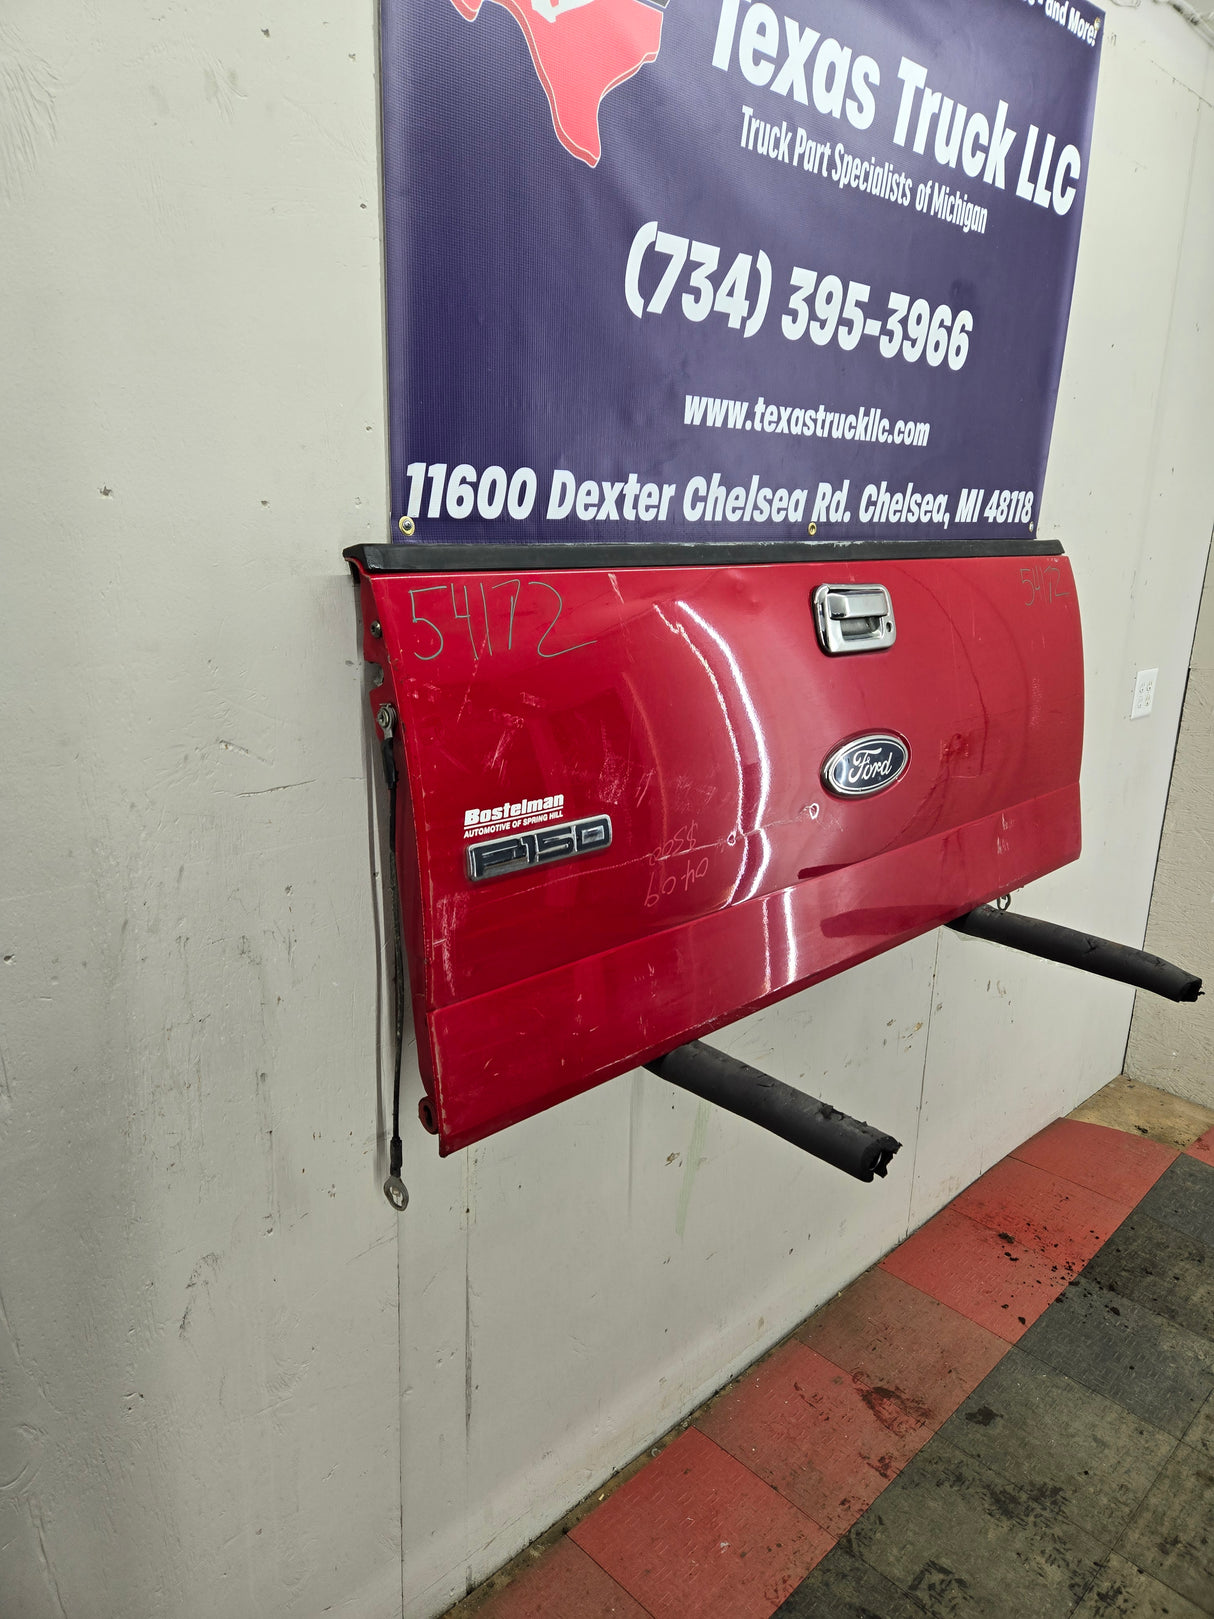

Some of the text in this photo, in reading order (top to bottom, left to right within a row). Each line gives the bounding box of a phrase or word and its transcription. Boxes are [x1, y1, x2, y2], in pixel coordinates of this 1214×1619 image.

[1045, 0, 1069, 26] and
[712, 0, 1081, 216] Texas Truck LLC
[740, 105, 988, 234] Truck Part Specialists of Michigan
[624, 221, 974, 371] (734) 395-3966
[684, 395, 931, 447] www.texastruckllc.com
[406, 462, 1034, 529] 11600 Dexter Chelsea Rd. Chelsea, MI 48118
[848, 748, 893, 783] Ford
[463, 810, 564, 839] AUTOMOTIVE OF SPRING HILL
[464, 794, 564, 826] Bostelman
